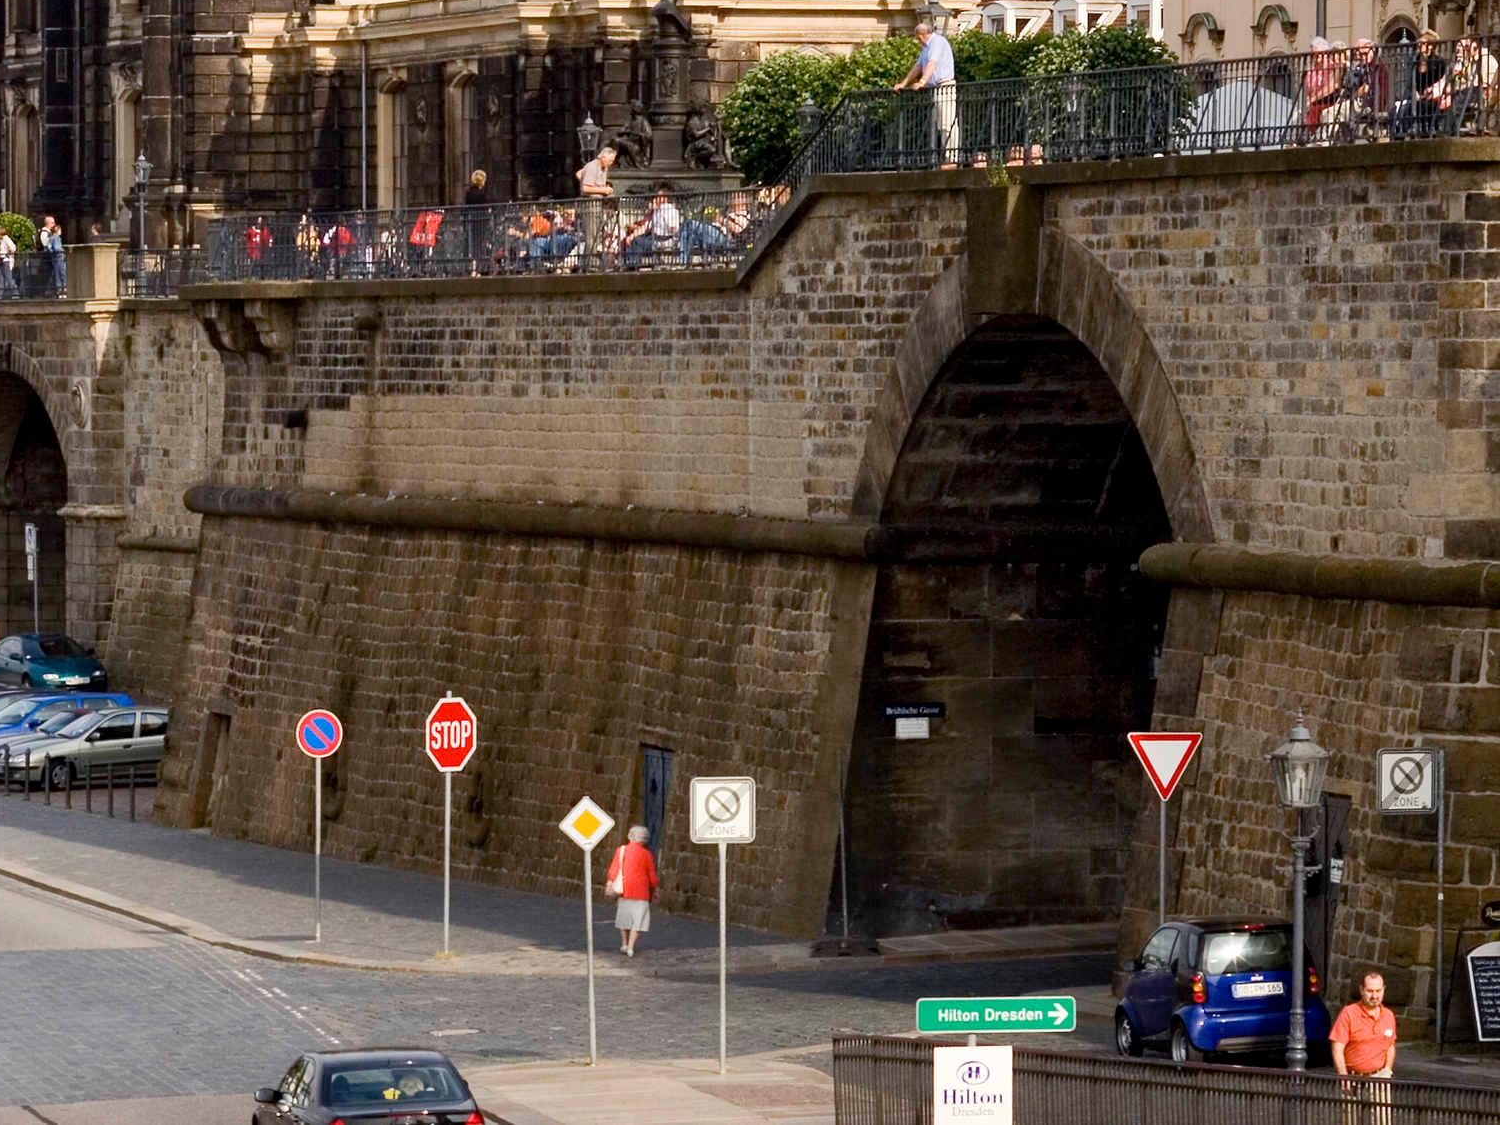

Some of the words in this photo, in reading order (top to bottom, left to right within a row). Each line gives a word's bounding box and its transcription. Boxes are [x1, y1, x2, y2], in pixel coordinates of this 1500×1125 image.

[431, 720, 472, 750] STOP
[1394, 795, 1420, 806] ZONE
[709, 824, 737, 836] ZONE
[938, 1008, 980, 1022] Hilton
[984, 1007, 1043, 1022] Dresden
[943, 1088, 1003, 1105] Hilton
[952, 1106, 995, 1116] Dresden
